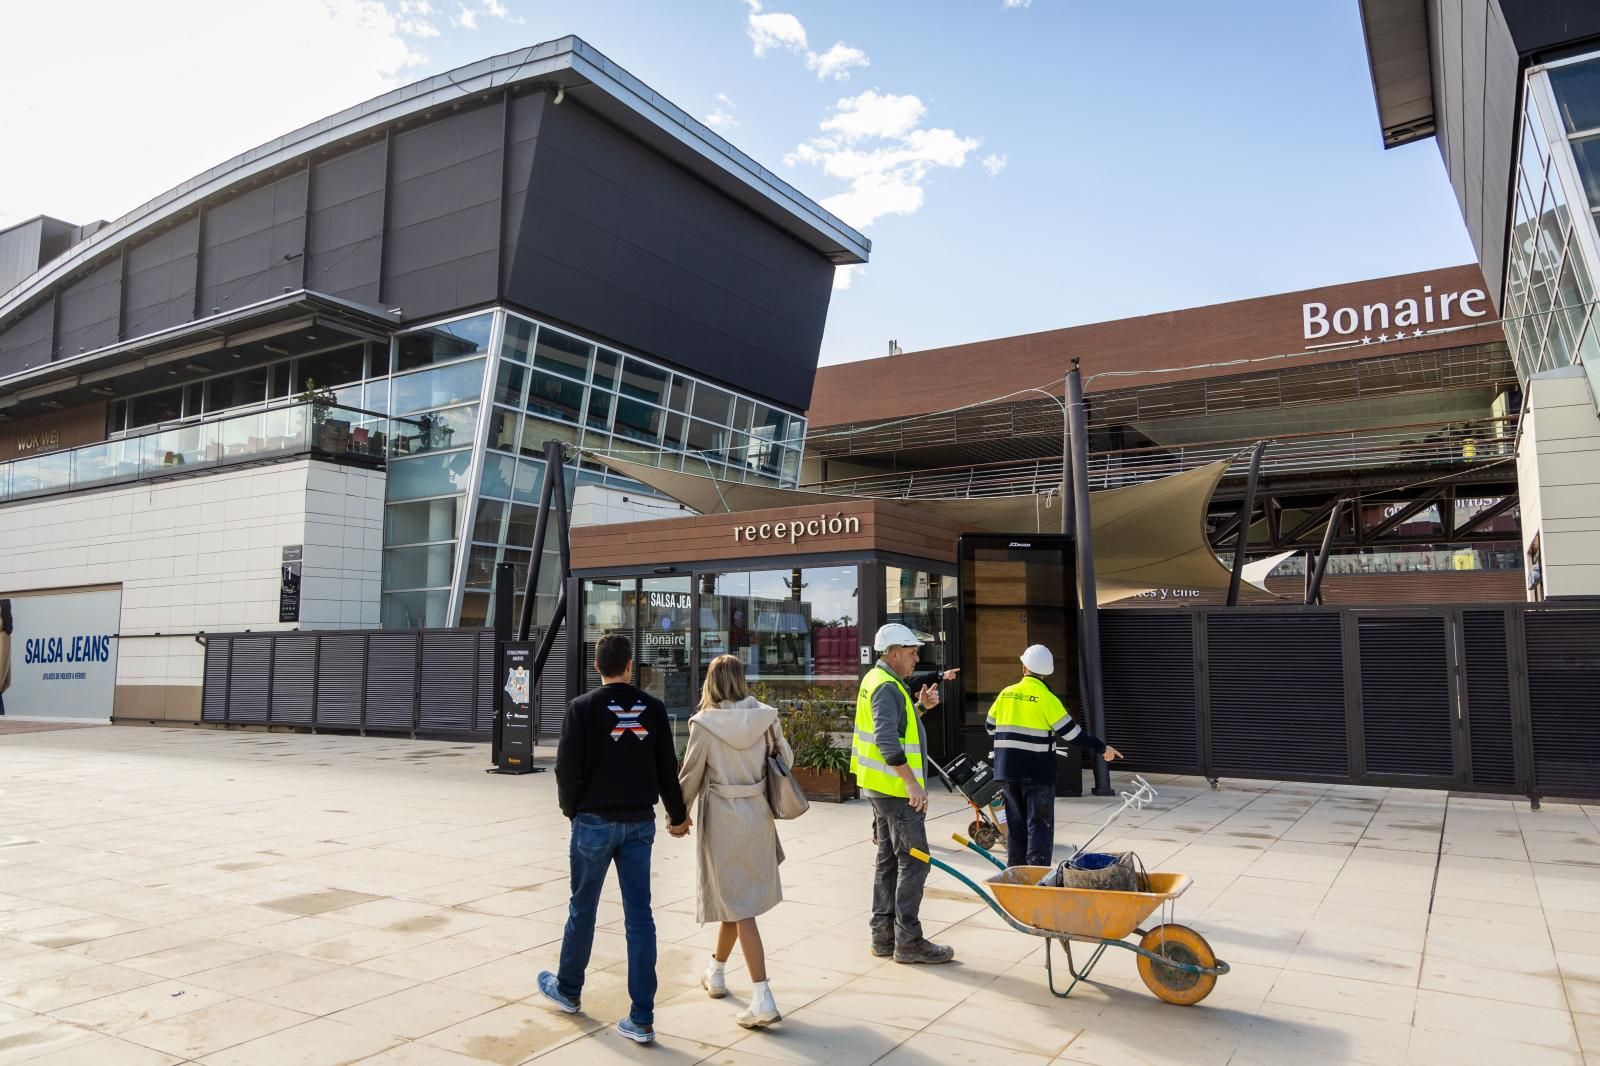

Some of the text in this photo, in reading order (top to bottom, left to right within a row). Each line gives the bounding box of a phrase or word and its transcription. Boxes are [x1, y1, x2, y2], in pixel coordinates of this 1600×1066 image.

[1302, 285, 1487, 340] Bonaire
[17, 433, 39, 450] WOK
[733, 512, 860, 544] recepción
[651, 592, 676, 609] SALSA
[25, 635, 110, 665] SALSA JEANS
[645, 632, 685, 646] Bonaire
